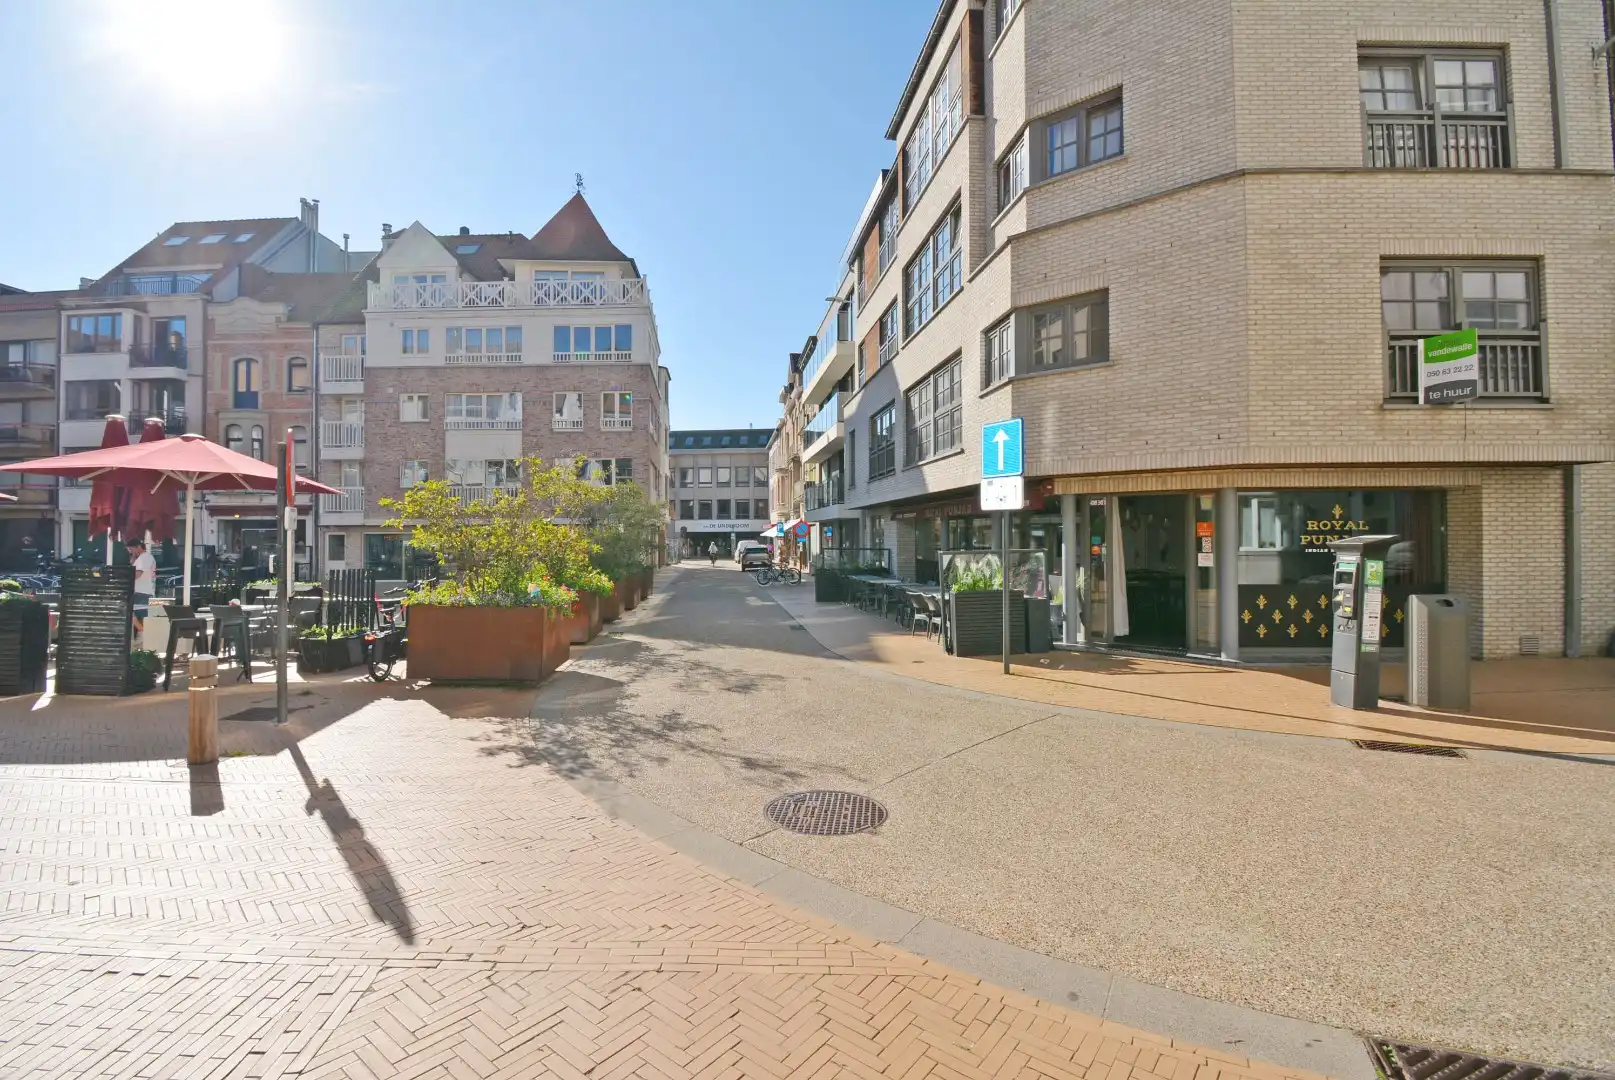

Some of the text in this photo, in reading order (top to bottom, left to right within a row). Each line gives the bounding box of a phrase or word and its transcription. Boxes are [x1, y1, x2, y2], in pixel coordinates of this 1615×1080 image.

[1453, 366, 1463, 374] 22
[1464, 364, 1474, 372] 22
[1429, 386, 1473, 400] te huur
[1306, 520, 1370, 531] ROYAL
[1300, 535, 1350, 545] PUN
